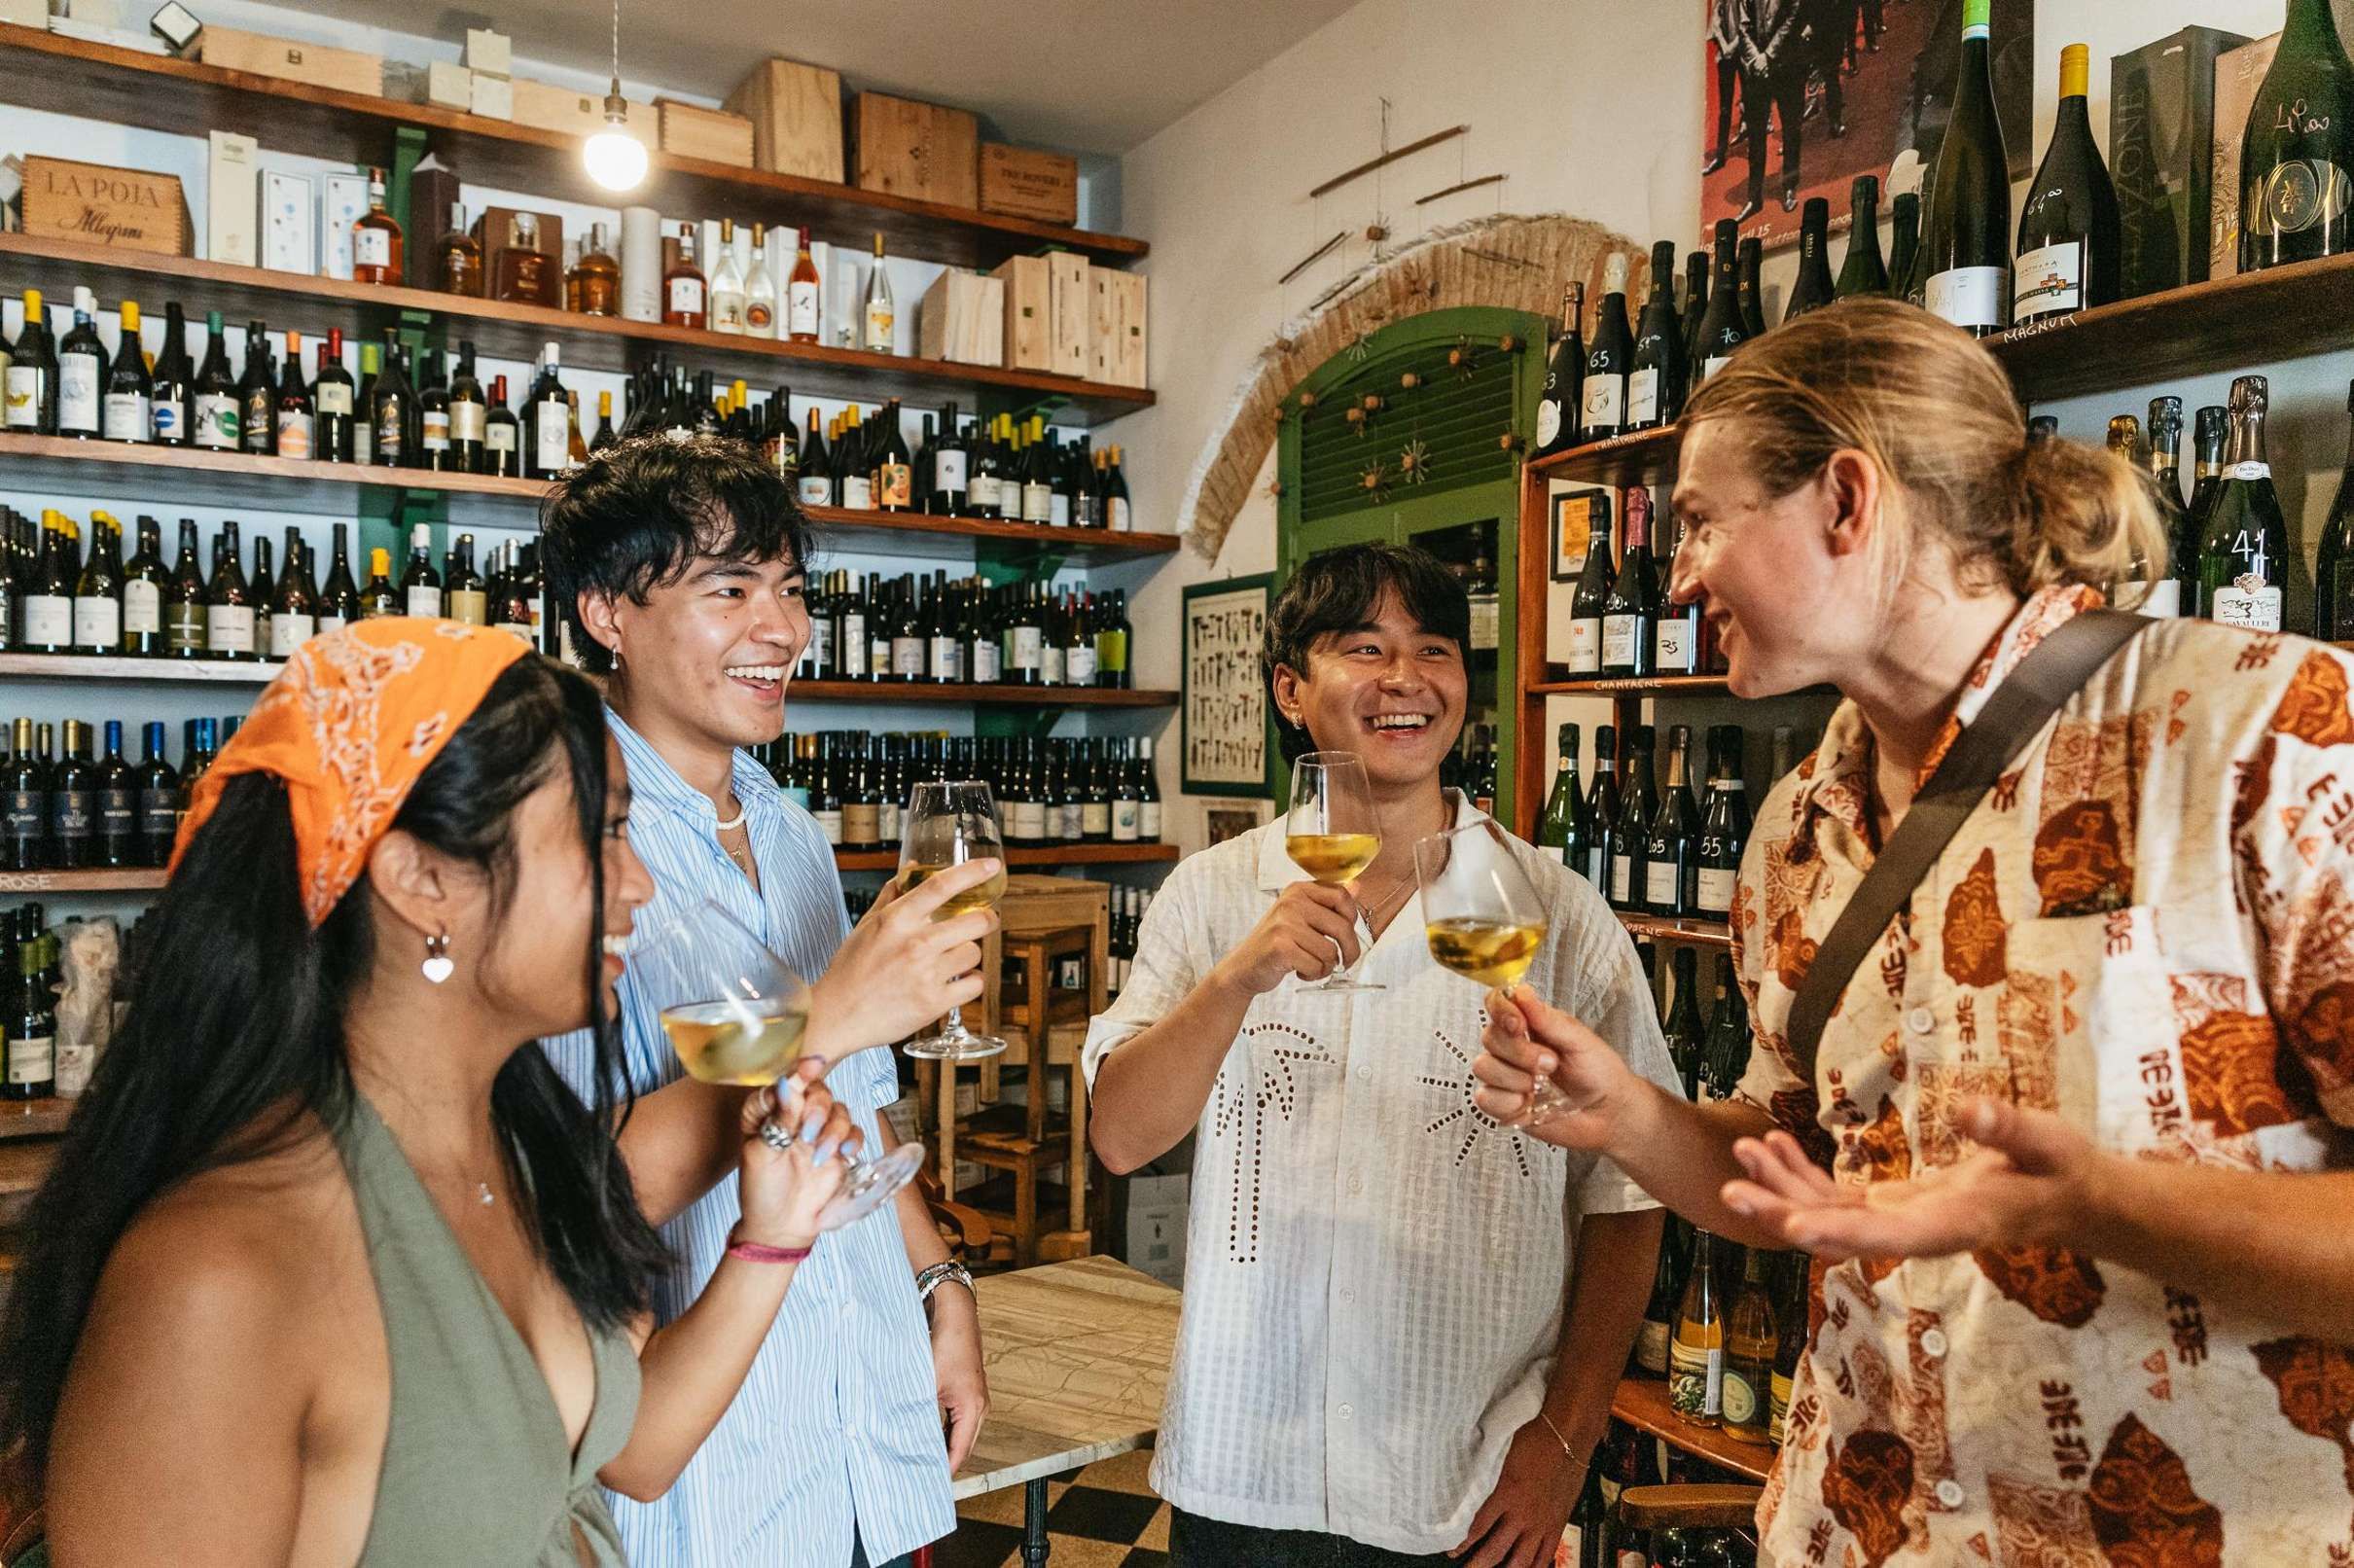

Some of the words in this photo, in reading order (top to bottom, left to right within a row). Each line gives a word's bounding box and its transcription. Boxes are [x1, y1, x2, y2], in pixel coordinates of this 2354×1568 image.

[48, 171, 83, 197] LA
[1721, 327, 1741, 343] 70
[2004, 313, 2078, 343] MAGNUM
[1589, 349, 1610, 368] 65
[2230, 527, 2270, 563] 41
[1594, 678, 1662, 692] CHAMPAGNE
[1700, 836, 1722, 857] 55
